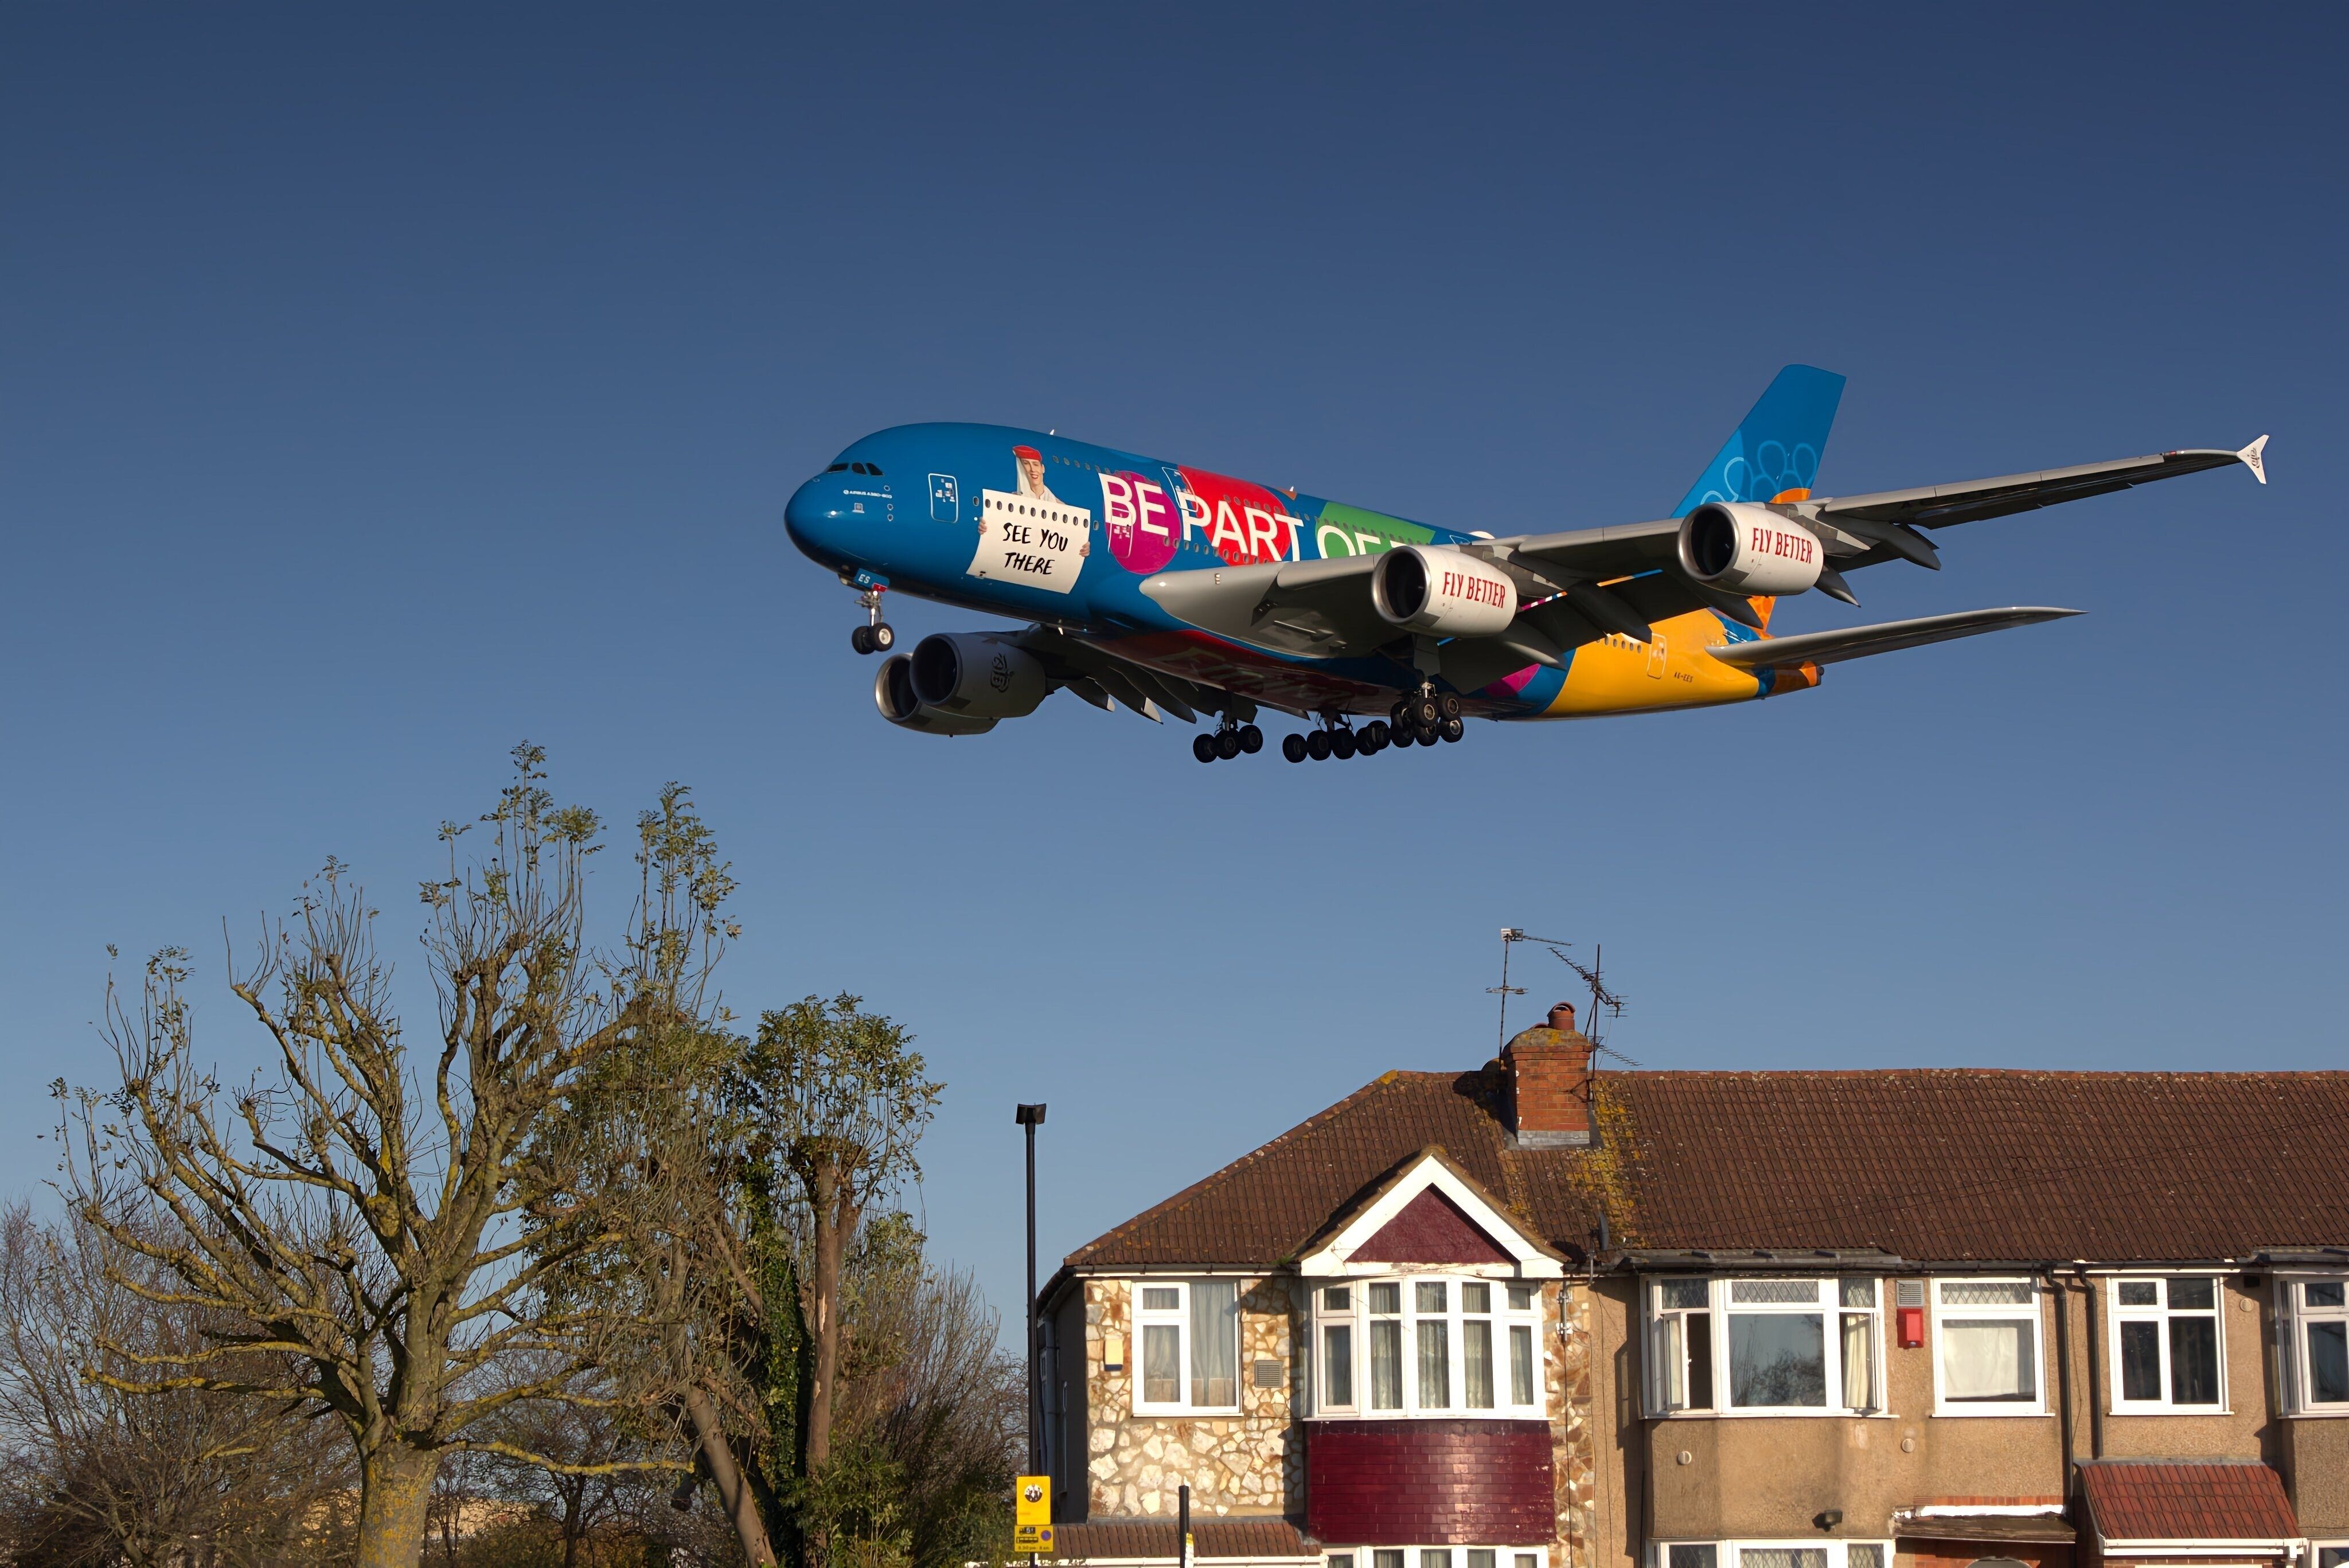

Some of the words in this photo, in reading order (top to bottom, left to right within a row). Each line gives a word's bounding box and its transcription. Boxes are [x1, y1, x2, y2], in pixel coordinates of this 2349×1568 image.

[1098, 473, 1169, 537] BE
[1176, 490, 1304, 562] PART
[1002, 522, 1032, 544] SEE
[1039, 528, 1068, 552] YOU
[1751, 527, 1772, 553] FLY
[1775, 532, 1812, 564] BETTER
[858, 574, 871, 584] ES
[1004, 552, 1055, 575] THERE
[1442, 571, 1464, 598] FLY
[1466, 576, 1505, 609] BETTER
